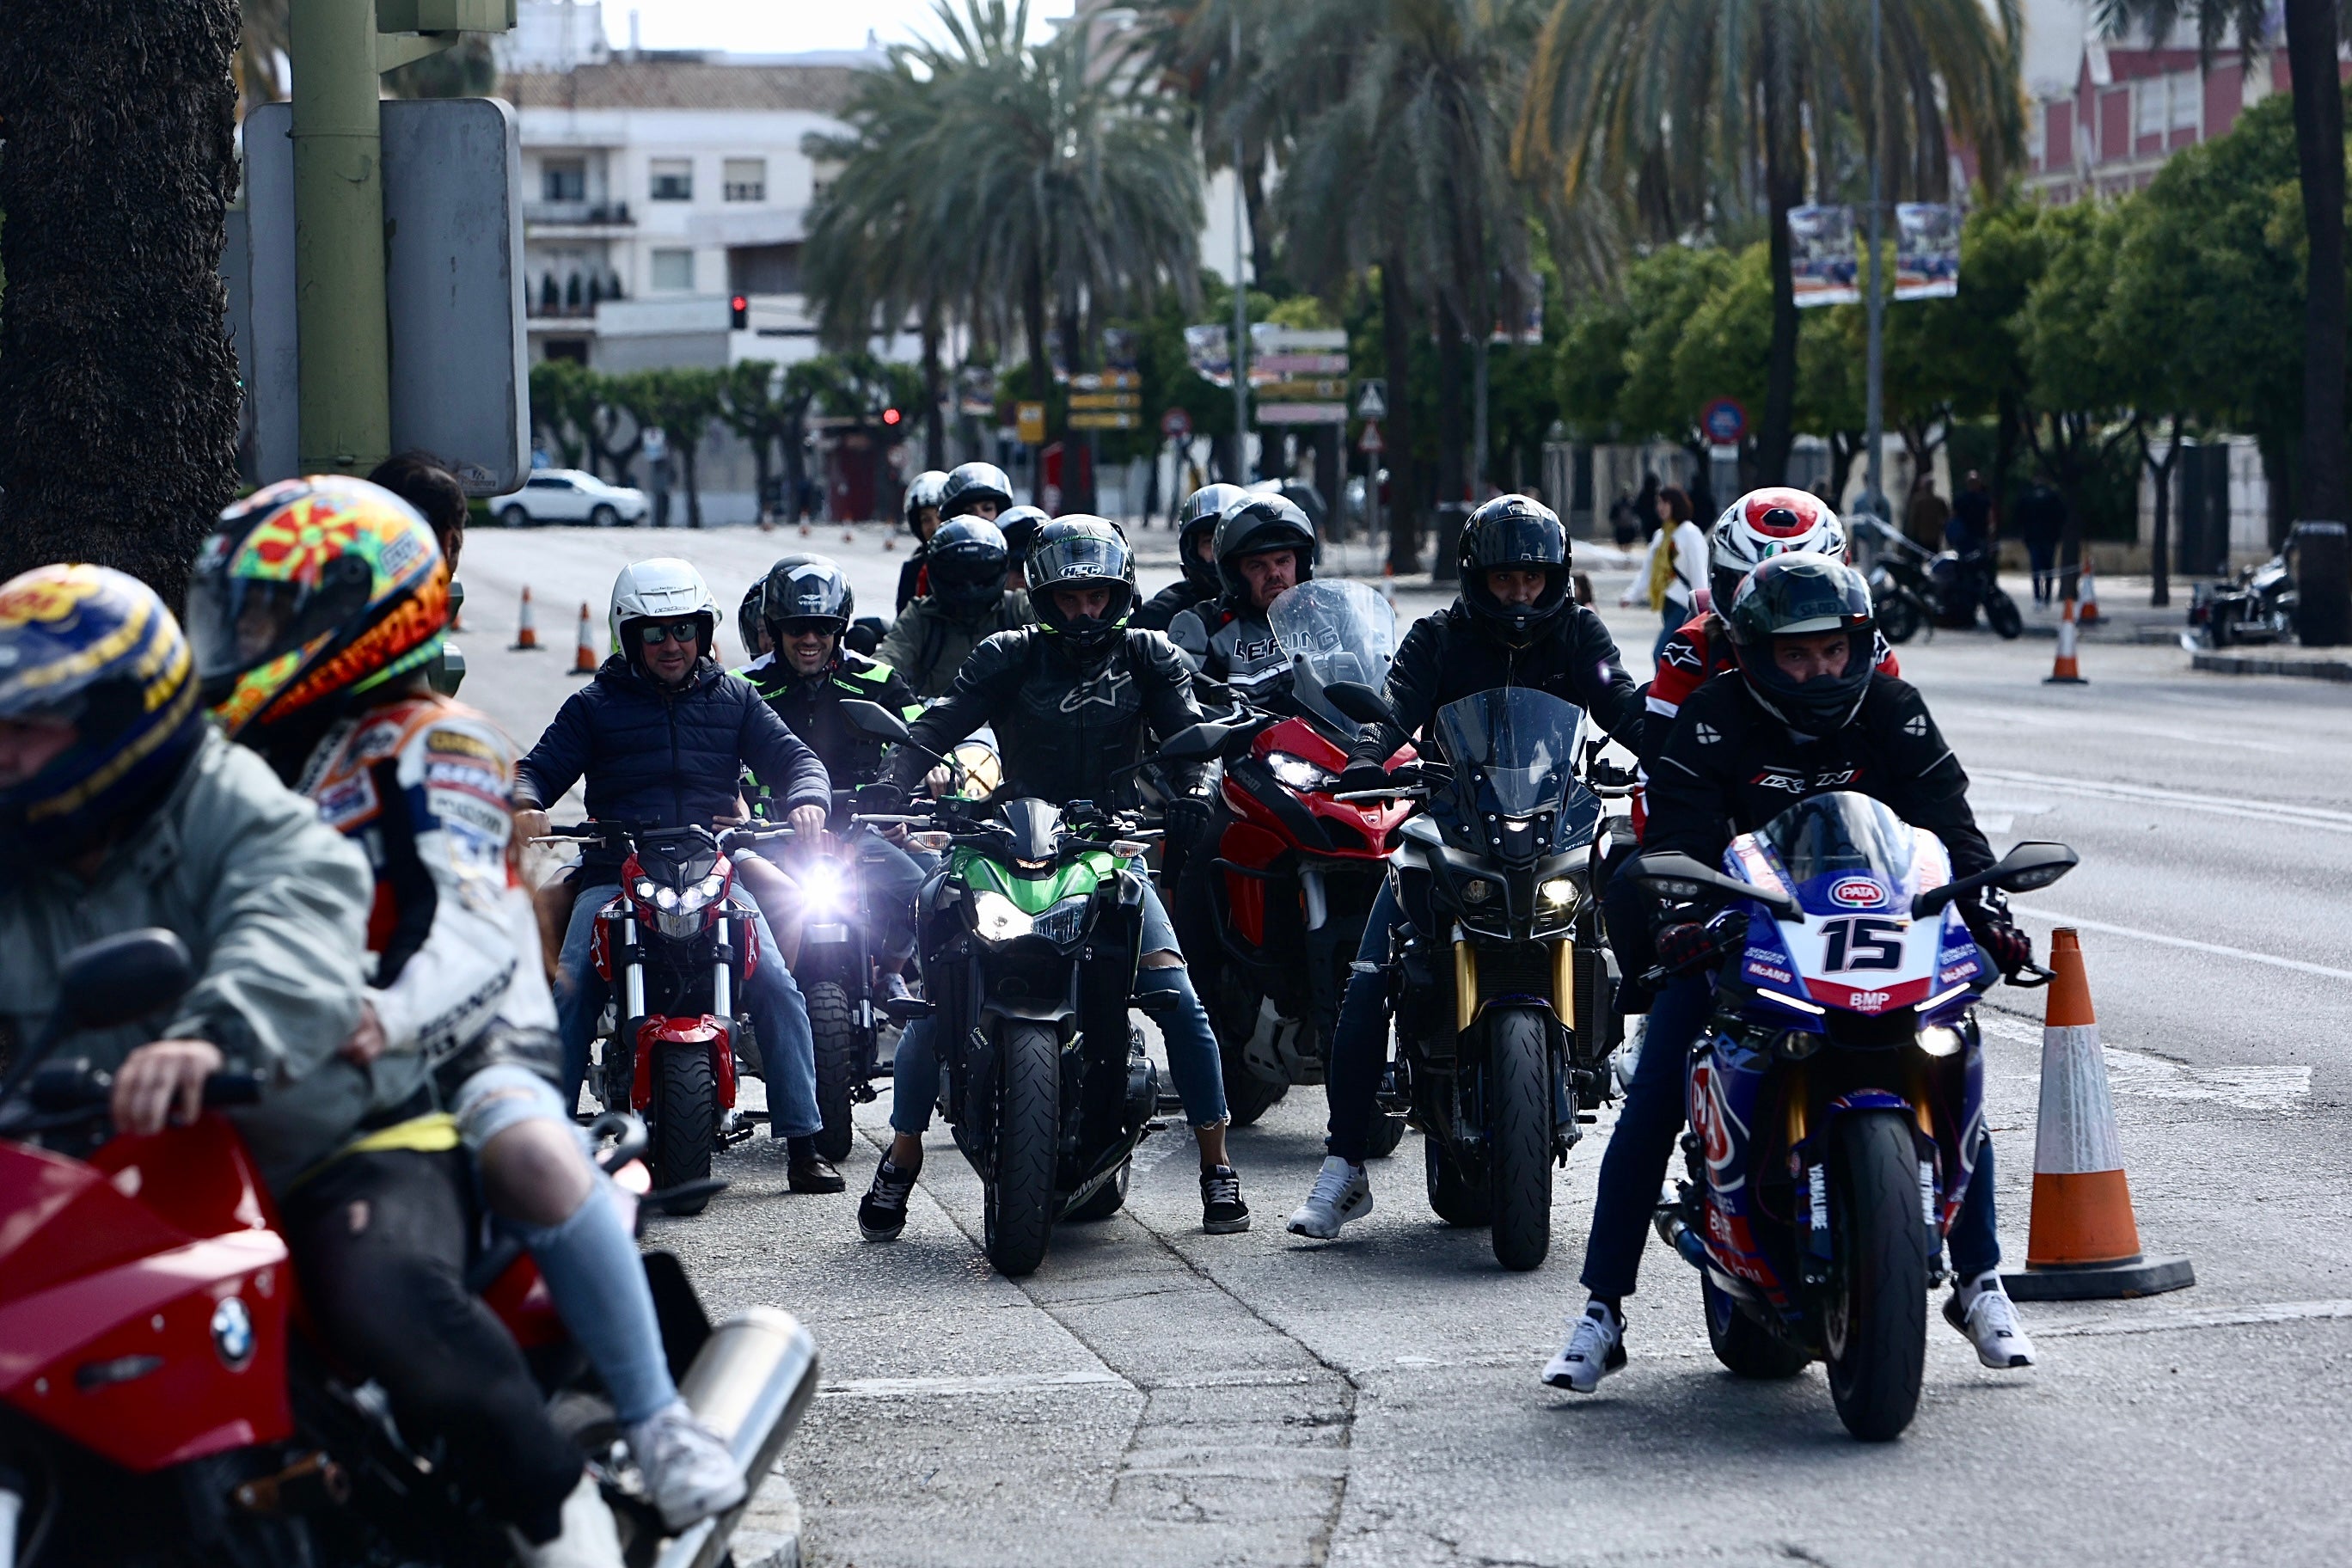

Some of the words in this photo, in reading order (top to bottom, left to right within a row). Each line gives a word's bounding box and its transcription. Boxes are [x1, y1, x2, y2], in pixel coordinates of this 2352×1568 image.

[1842, 886, 1877, 898] PATA
[1817, 916, 1908, 975] 15
[1748, 963, 1792, 983] McAMS
[1939, 961, 1978, 983] McAMS
[1849, 991, 1890, 1007] BMP
[1808, 1162, 1828, 1231] YAMALUBE
